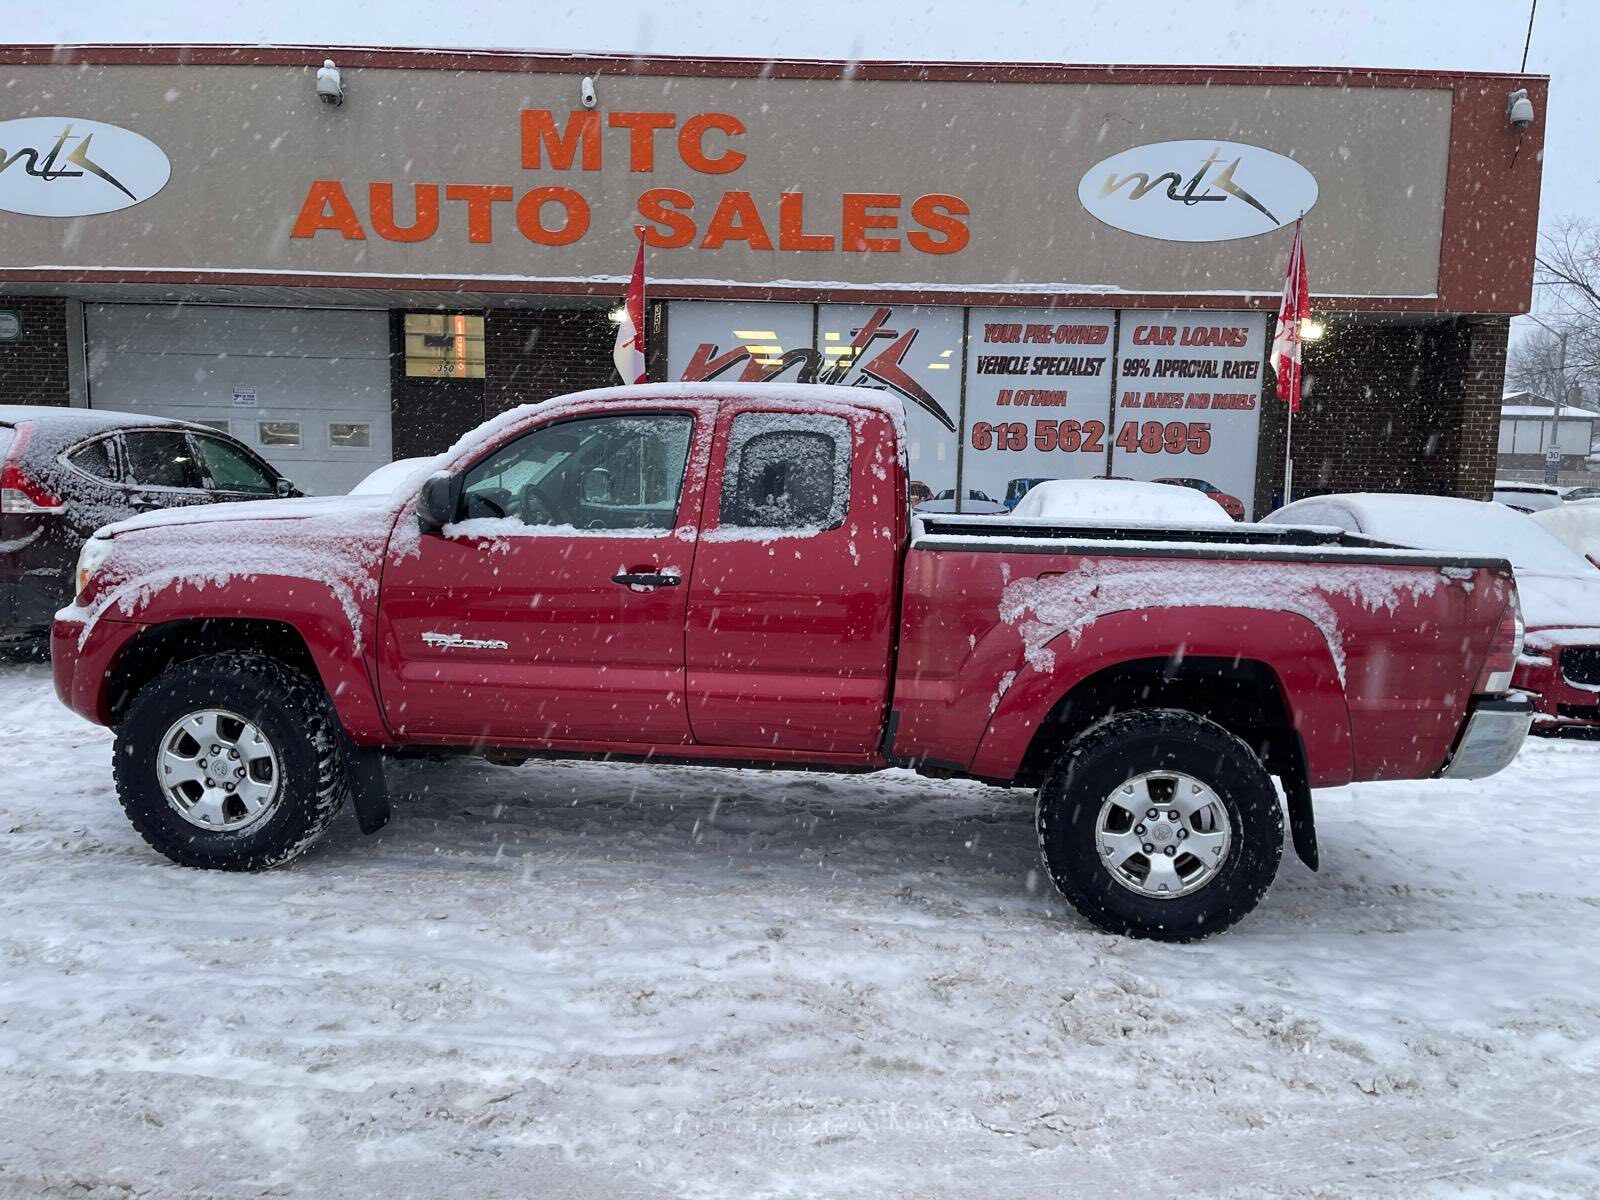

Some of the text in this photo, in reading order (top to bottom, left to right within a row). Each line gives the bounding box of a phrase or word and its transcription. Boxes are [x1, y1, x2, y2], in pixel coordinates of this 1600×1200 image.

[520, 109, 747, 174] MTC
[290, 180, 970, 255] AUTO SALES
[984, 323, 1109, 345] YOUR PRE-OWNED
[1133, 325, 1249, 348] CAR LOANS
[437, 364, 455, 373] 350
[977, 355, 1106, 377] VEHICLE SPECIALIST
[1122, 358, 1260, 380] 99% APPROVAL RATE!
[997, 389, 1067, 407] IN OTTAWA
[1120, 391, 1256, 411] ALL MAKES AND MODELS
[971, 419, 1211, 455] 613 562 4895
[1547, 451, 1559, 459] 30
